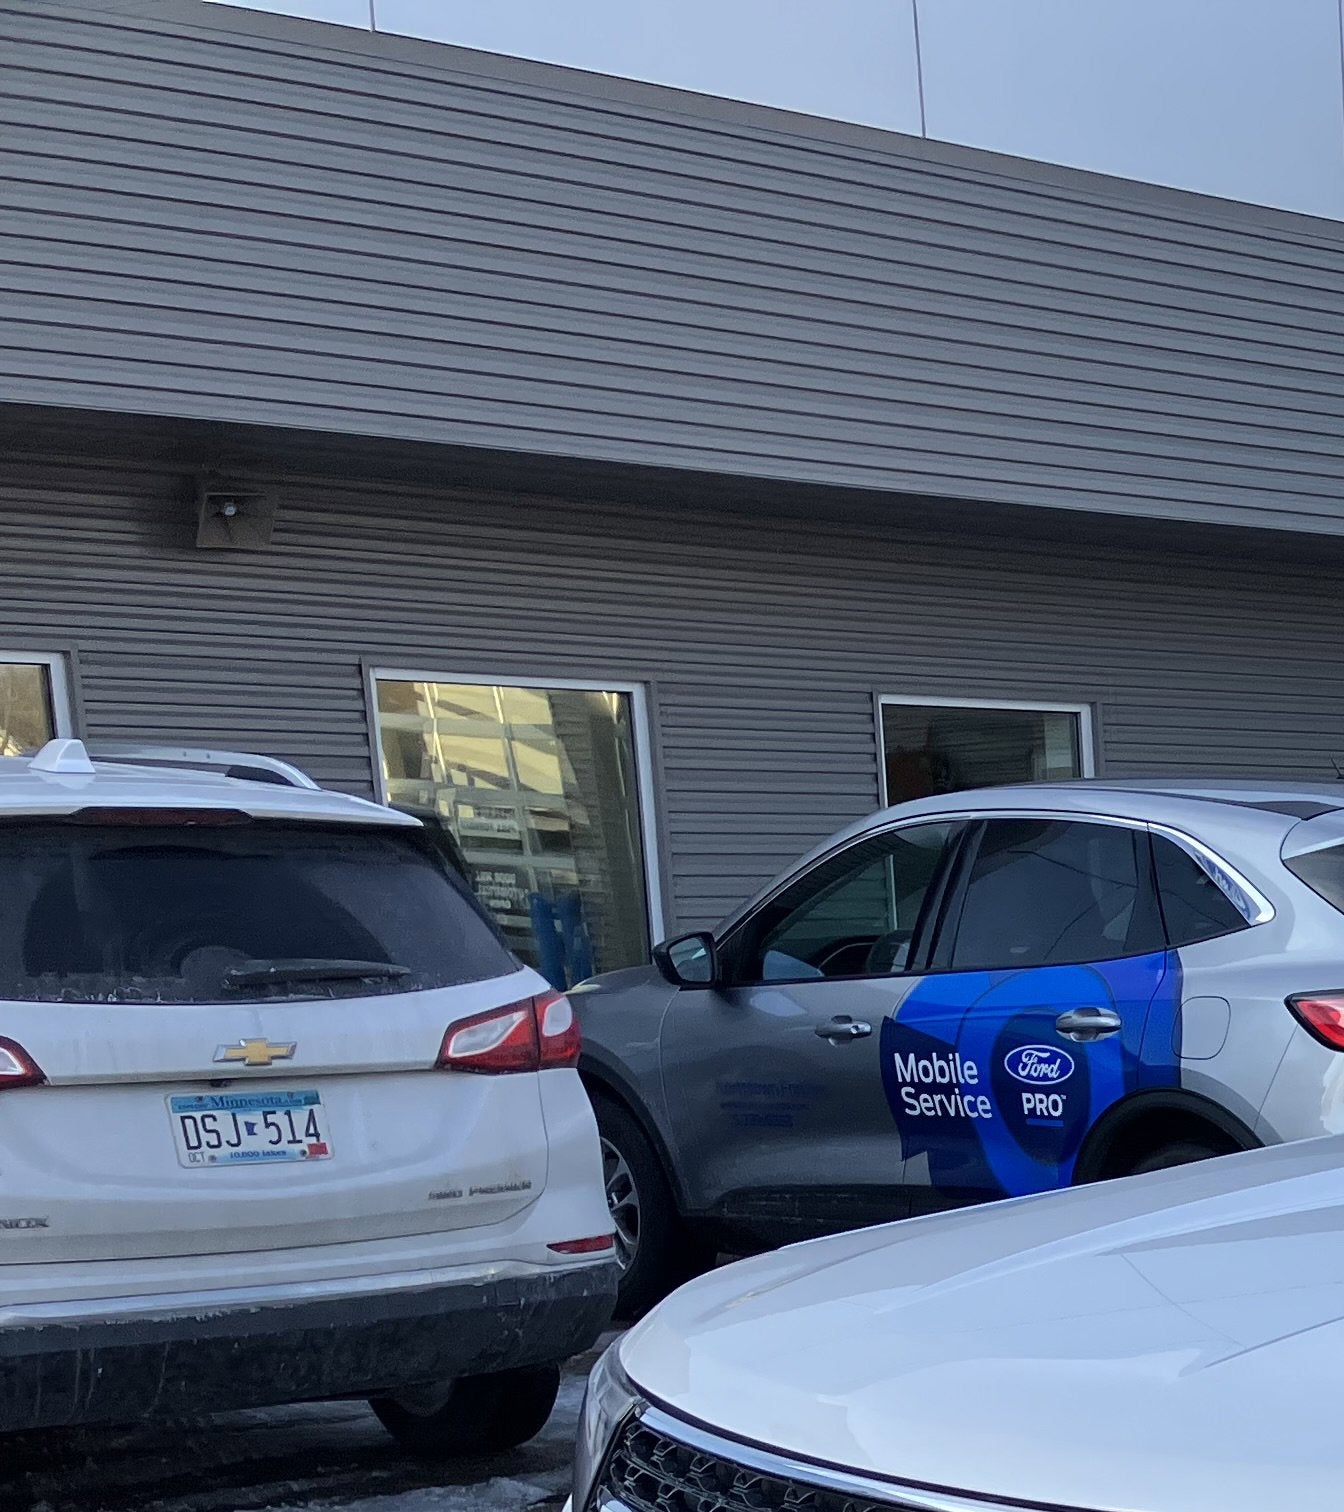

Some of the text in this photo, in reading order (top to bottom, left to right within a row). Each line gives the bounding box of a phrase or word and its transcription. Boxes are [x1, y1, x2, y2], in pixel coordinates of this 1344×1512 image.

[894, 1052, 979, 1085] Mobile
[1018, 1049, 1061, 1079] Ford
[900, 1086, 993, 1119] Service
[180, 1108, 321, 1150] DSJ 514
